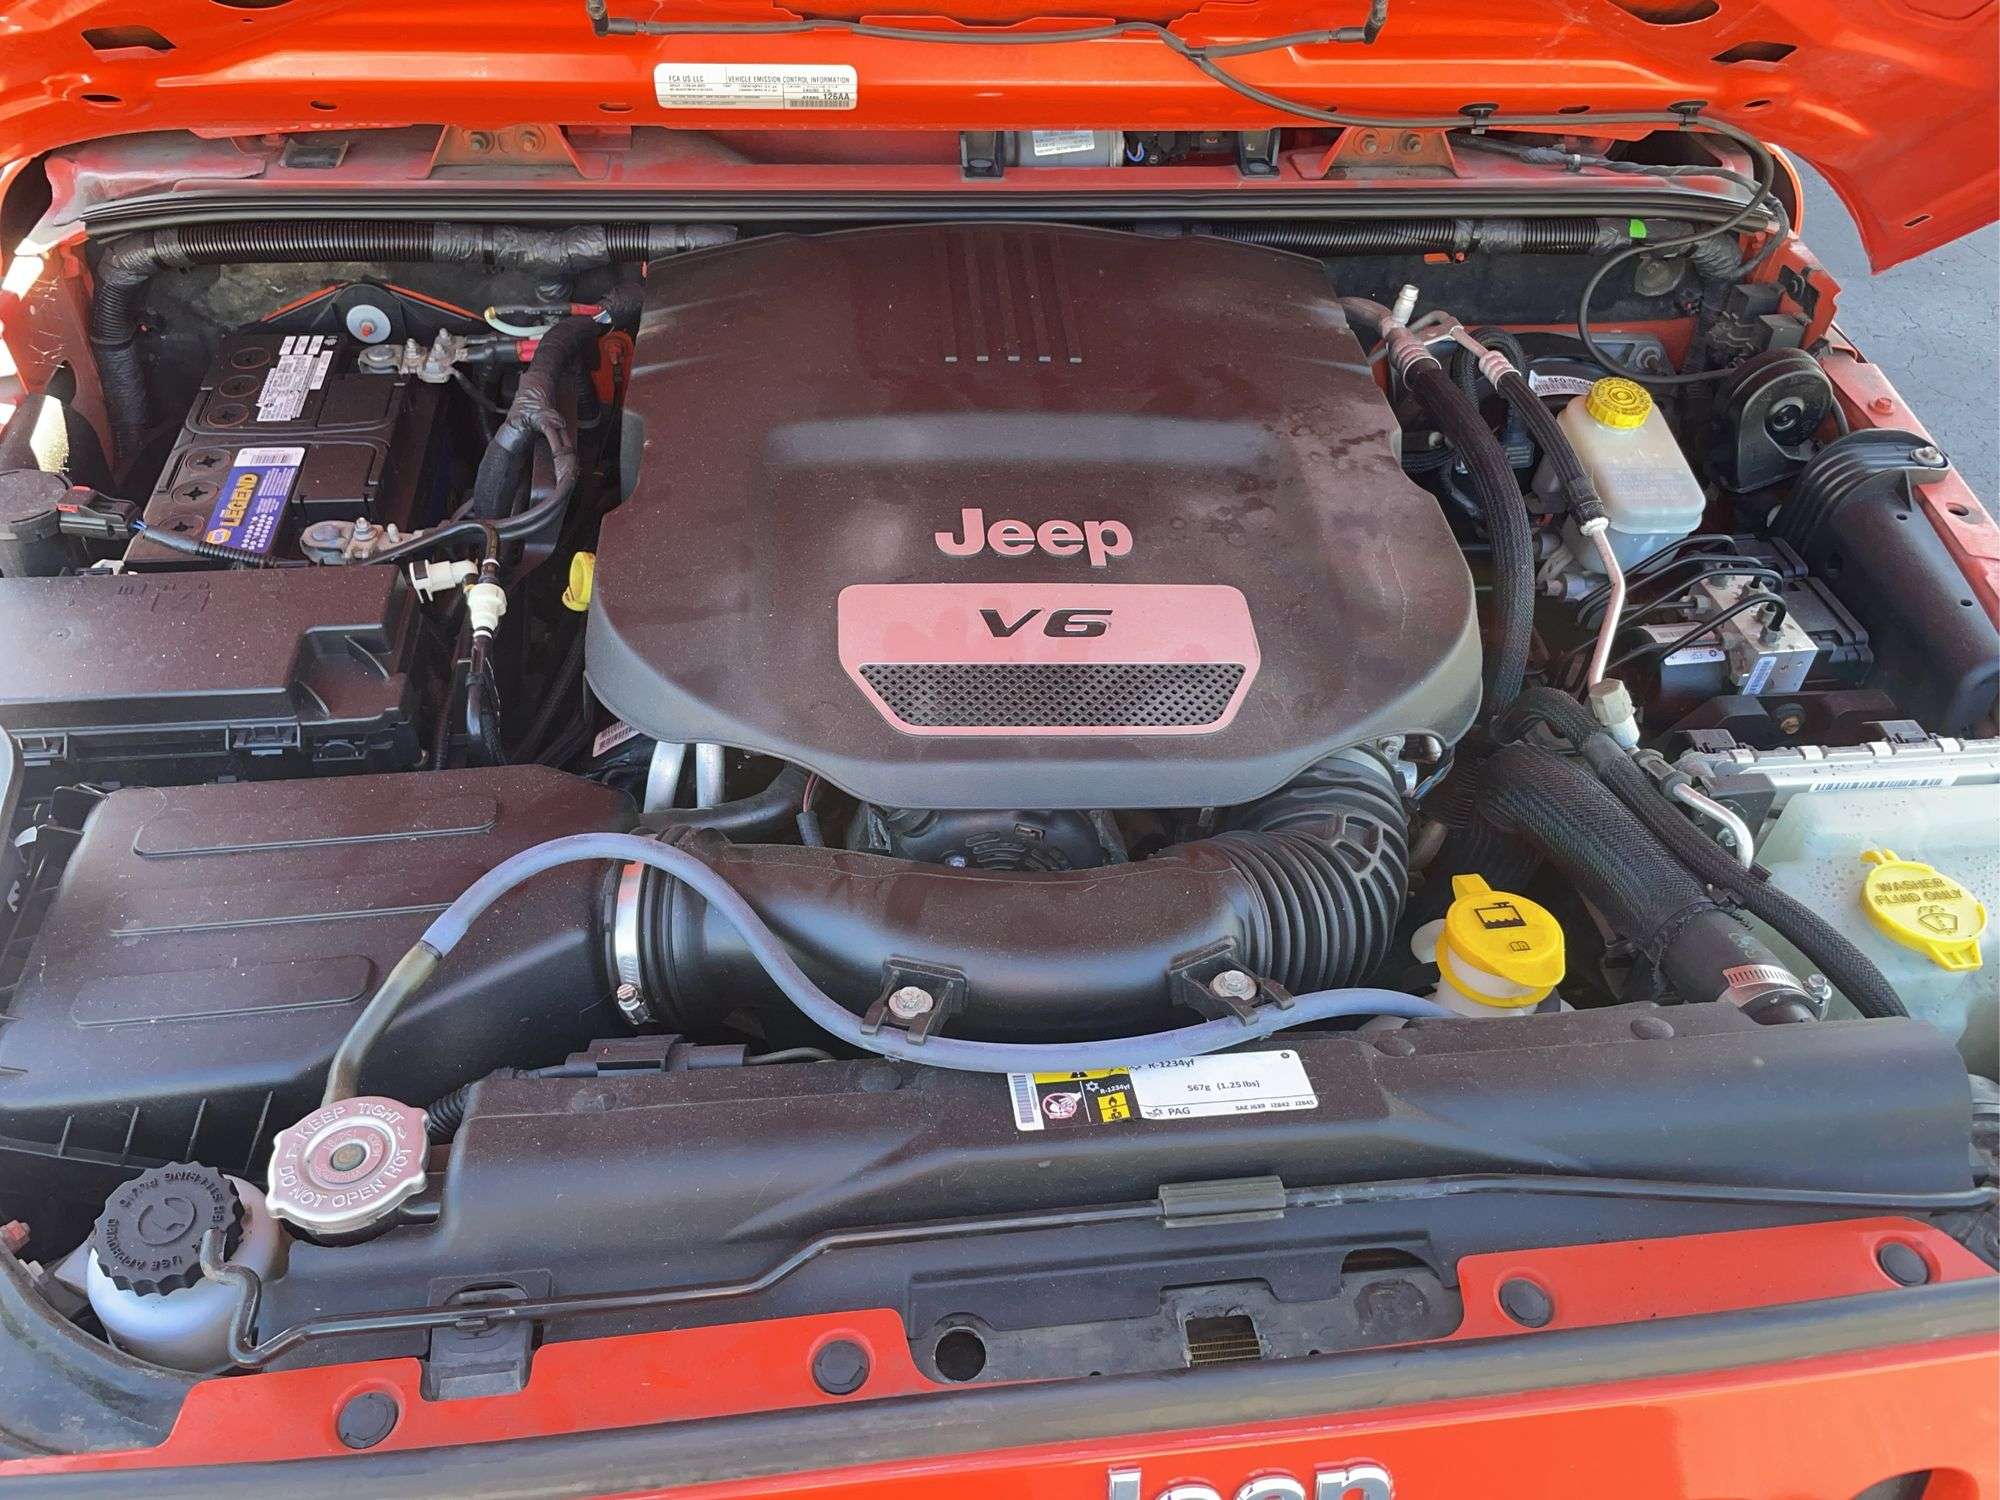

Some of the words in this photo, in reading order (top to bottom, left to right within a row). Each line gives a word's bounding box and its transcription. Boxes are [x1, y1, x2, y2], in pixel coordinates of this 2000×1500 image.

[823, 92, 850, 101] 126AA
[221, 473, 259, 527] LEGEND
[934, 507, 1134, 568] Jeep
[979, 608, 1114, 638] V6
[1873, 892, 1922, 905] FLUID
[1923, 889, 1963, 901] ONLY
[1876, 877, 1946, 893] WASHER
[1186, 1083, 1212, 1093] 567g
[295, 1105, 348, 1140] KEEP
[357, 1102, 406, 1124] TIGHT
[1168, 1107, 1192, 1117] PAG
[279, 1165, 298, 1188] DO
[383, 1148, 413, 1179] HOT
[288, 1183, 329, 1209] NOT
[331, 1178, 388, 1209] OPEN
